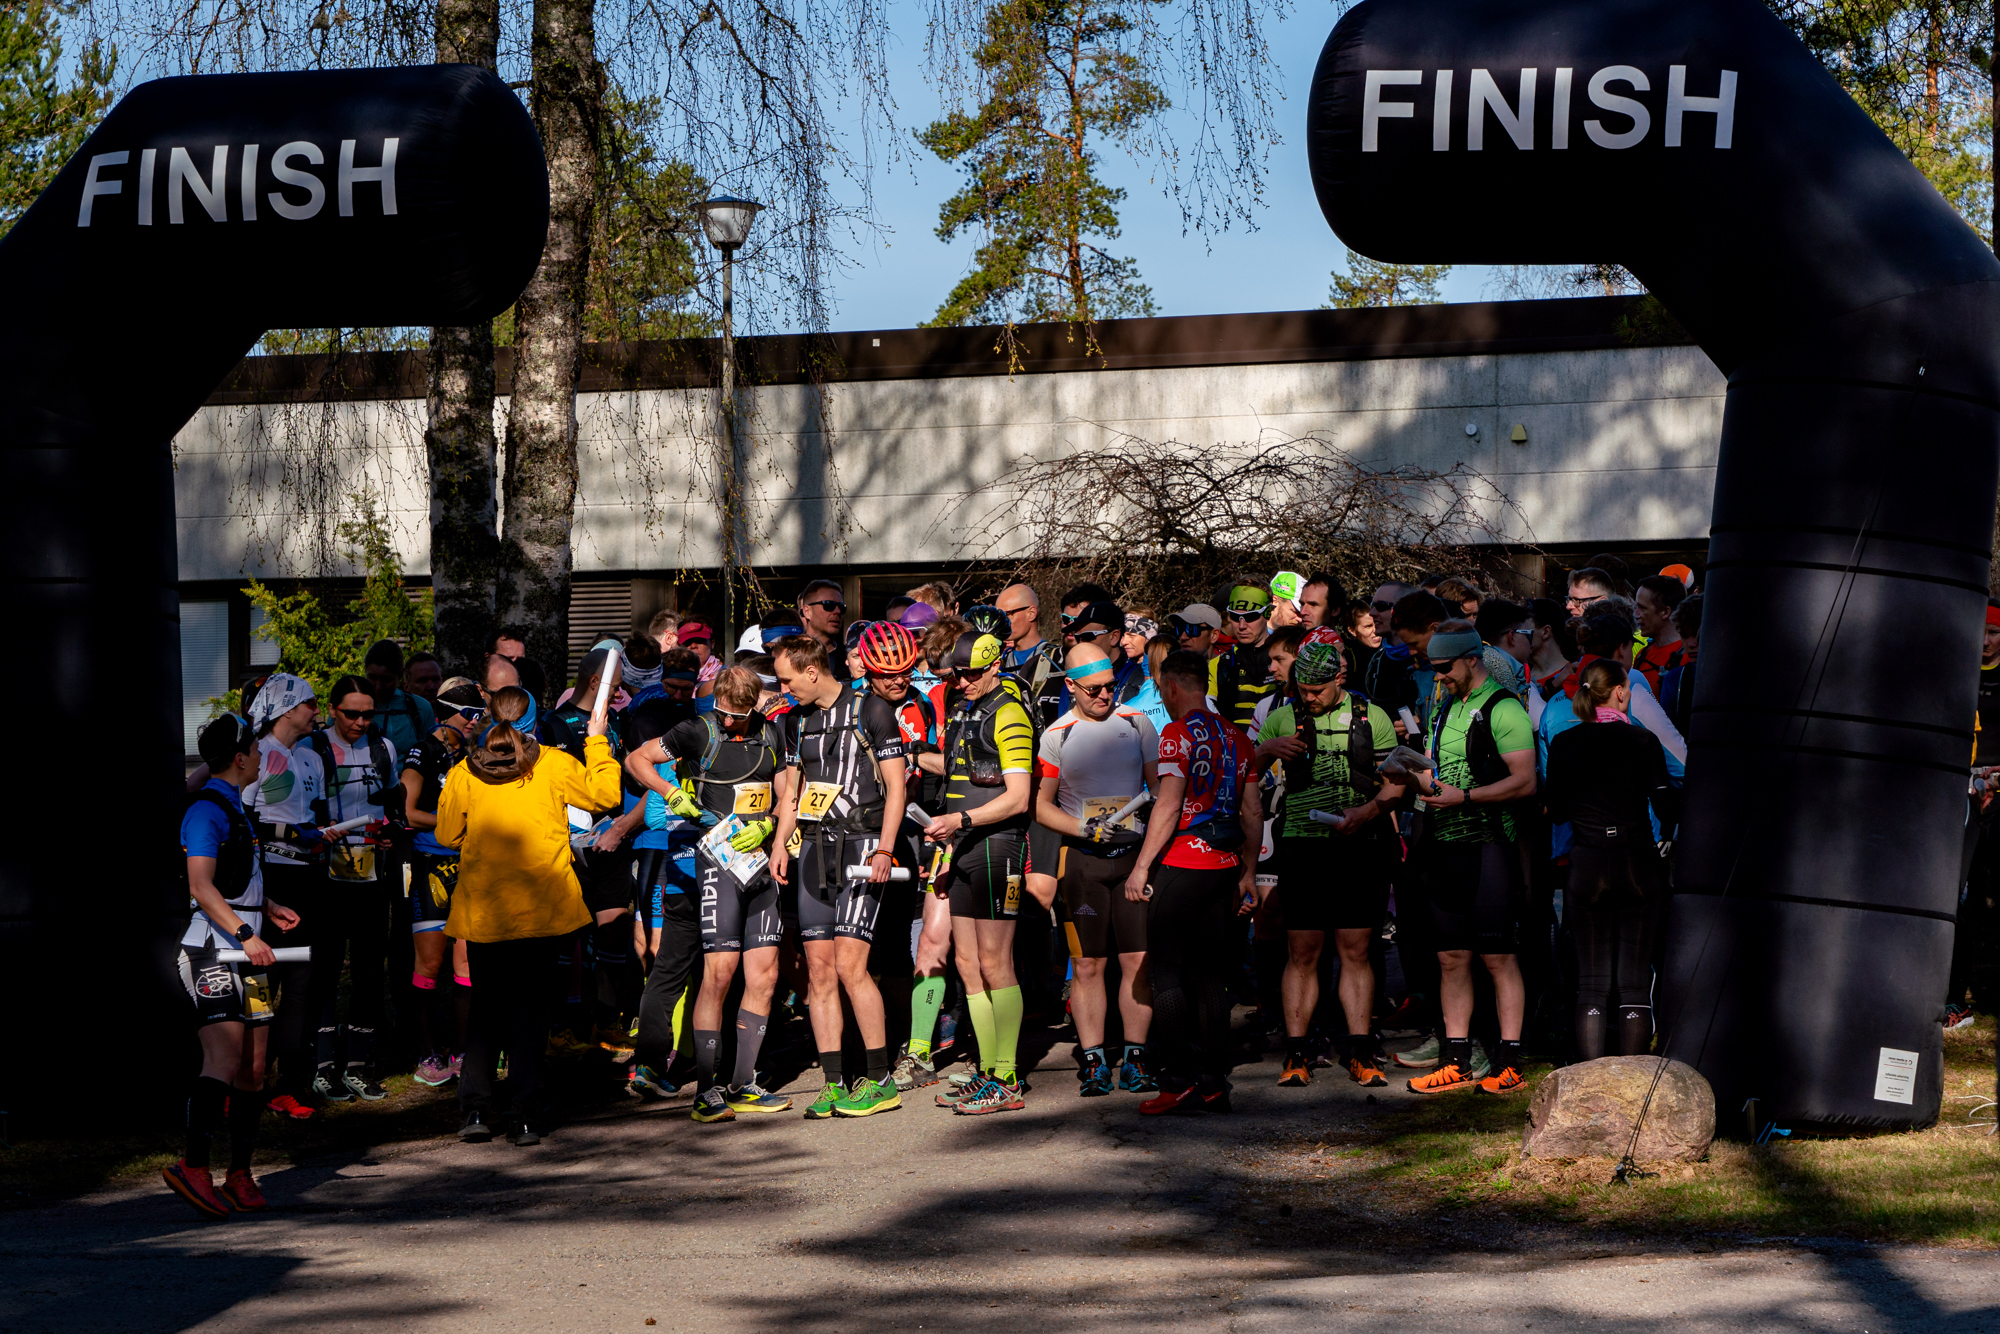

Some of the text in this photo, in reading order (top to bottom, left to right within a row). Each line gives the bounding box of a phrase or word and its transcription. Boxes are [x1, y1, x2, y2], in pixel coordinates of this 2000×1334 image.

[1361, 64, 1739, 152] FINISH
[77, 137, 400, 228] FINISH
[1186, 718, 1212, 777] race
[749, 793, 764, 808] 27
[810, 792, 828, 808] 27
[345, 856, 364, 871] 41
[412, 890, 423, 921] KARSU
[651, 885, 663, 916] KARSU
[700, 867, 719, 935] HALTI
